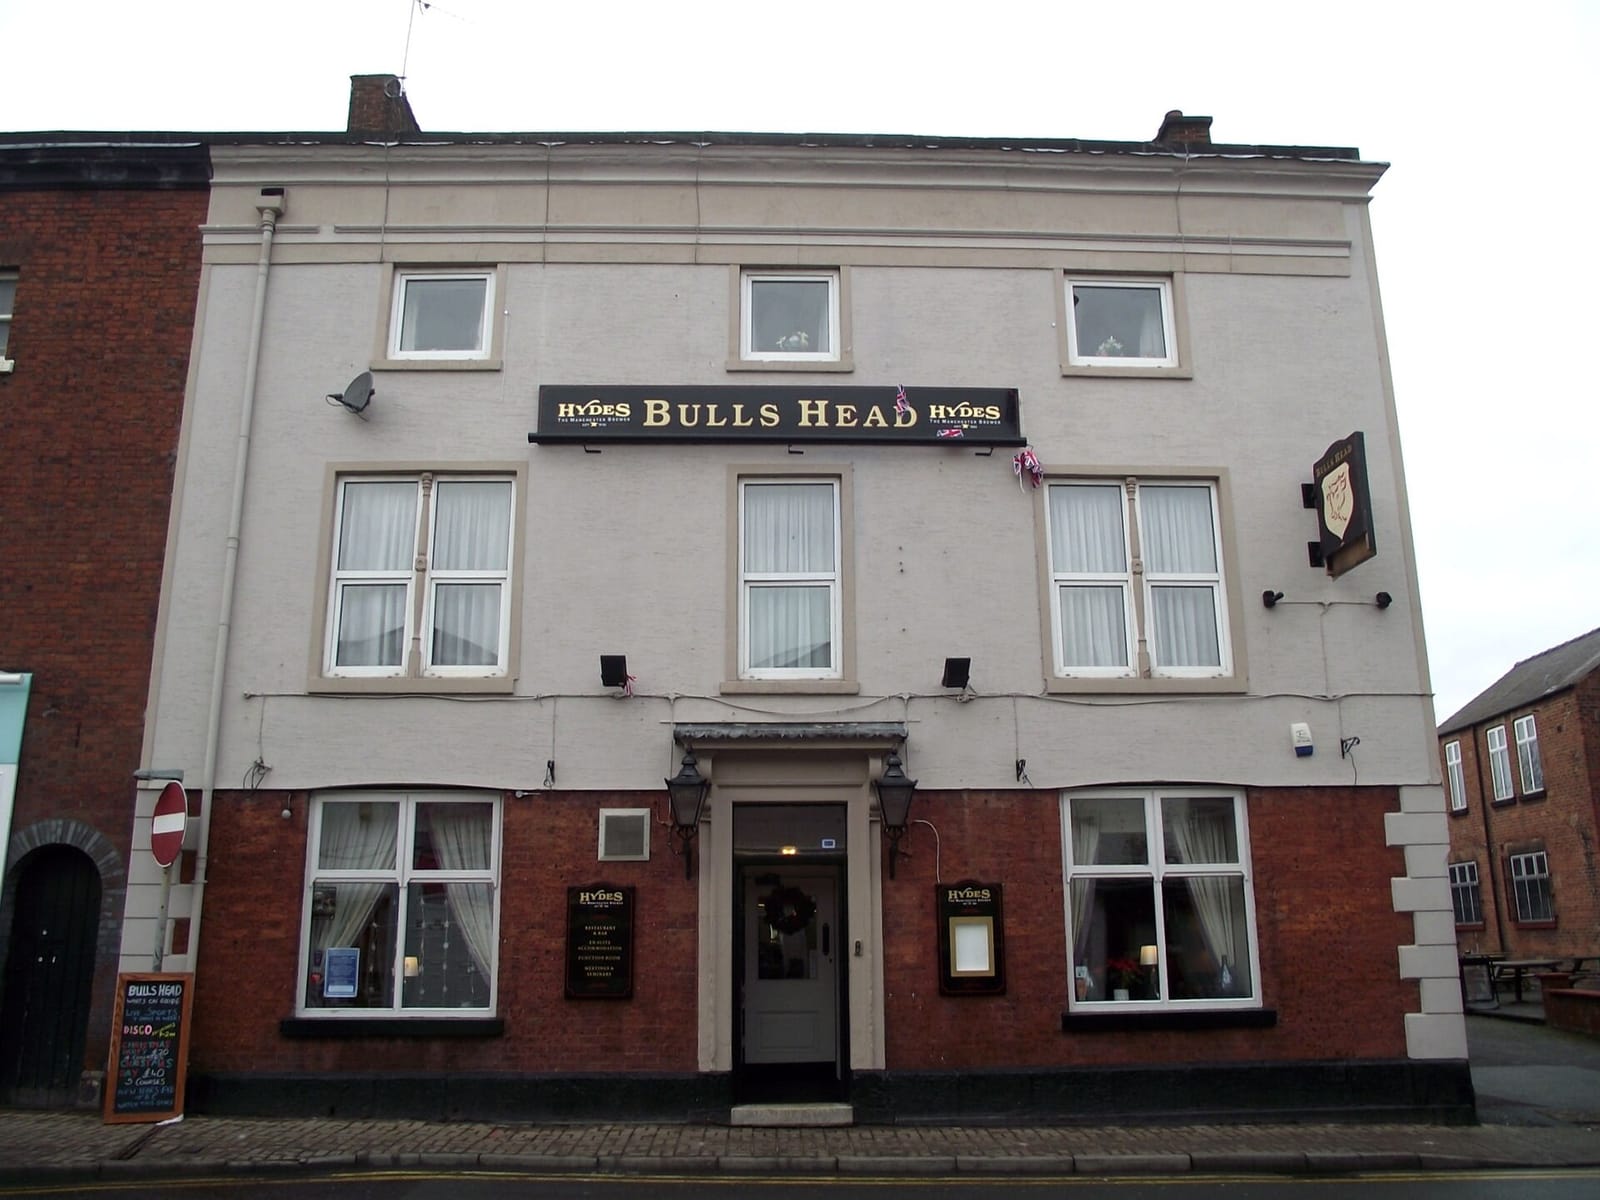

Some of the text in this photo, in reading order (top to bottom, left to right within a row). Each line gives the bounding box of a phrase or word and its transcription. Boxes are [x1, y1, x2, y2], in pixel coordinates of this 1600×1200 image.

[558, 399, 631, 417] HYDES
[643, 399, 918, 428] BULLS HEAD
[929, 401, 1001, 420] HYDES
[579, 889, 623, 901] HYDES
[948, 887, 991, 899] HYDES
[127, 984, 182, 997] BULLS HEAD
[123, 1024, 153, 1036] DISCO
